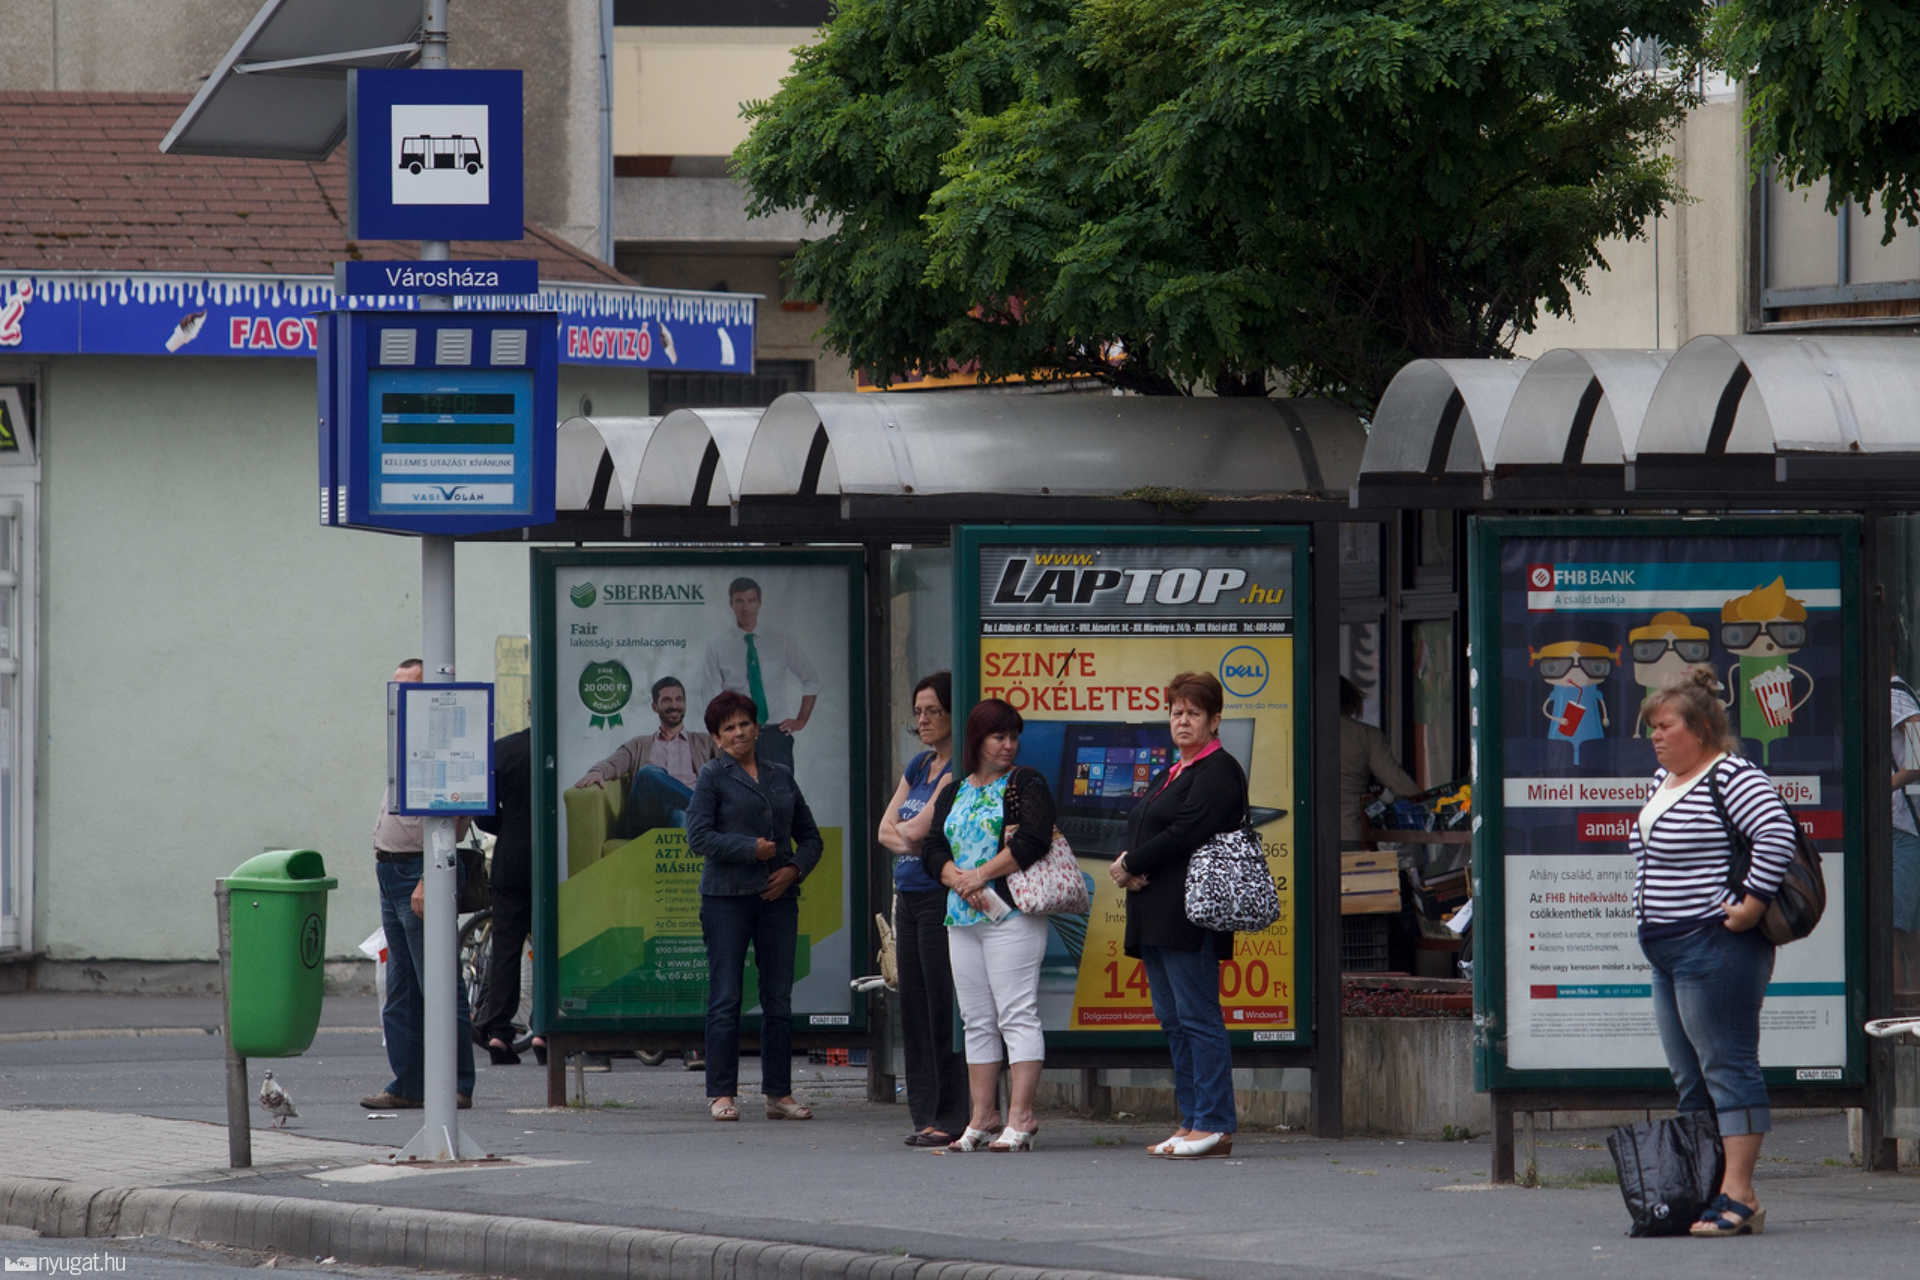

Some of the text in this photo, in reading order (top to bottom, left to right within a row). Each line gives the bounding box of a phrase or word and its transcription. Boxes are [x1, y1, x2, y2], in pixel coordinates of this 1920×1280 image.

[385, 267, 499, 287] Városháza
[568, 322, 651, 361] FAGYIZÓ
[384, 456, 512, 467] KELLEMES UTAZÁST KÍVÁNUNK
[1034, 553, 1095, 566] www.
[991, 556, 1247, 606] LAPTOP
[1553, 569, 1636, 585] FHB BANK
[602, 584, 705, 601] SBERBANK
[1595, 594, 1626, 607] bankja
[570, 622, 599, 636] Fair
[570, 636, 687, 648] lakossági számlacsomag
[984, 652, 1097, 677] SZINTE
[1225, 664, 1264, 678] DELL
[984, 680, 1169, 711] TÖKÉLETES!
[1527, 783, 1574, 800] Minél
[1585, 819, 1630, 836] annál
[655, 848, 682, 859] AZT
[1529, 870, 1559, 883] Ahány
[1561, 868, 1595, 882] család,
[1597, 869, 1620, 883] annyi
[1530, 891, 1629, 904] Az FHB hitelkiváltó
[1529, 907, 1602, 919] csökkenthetik
[1106, 940, 1118, 957] 3
[1273, 982, 1288, 998] Ft
[1245, 1009, 1277, 1020] Windows
